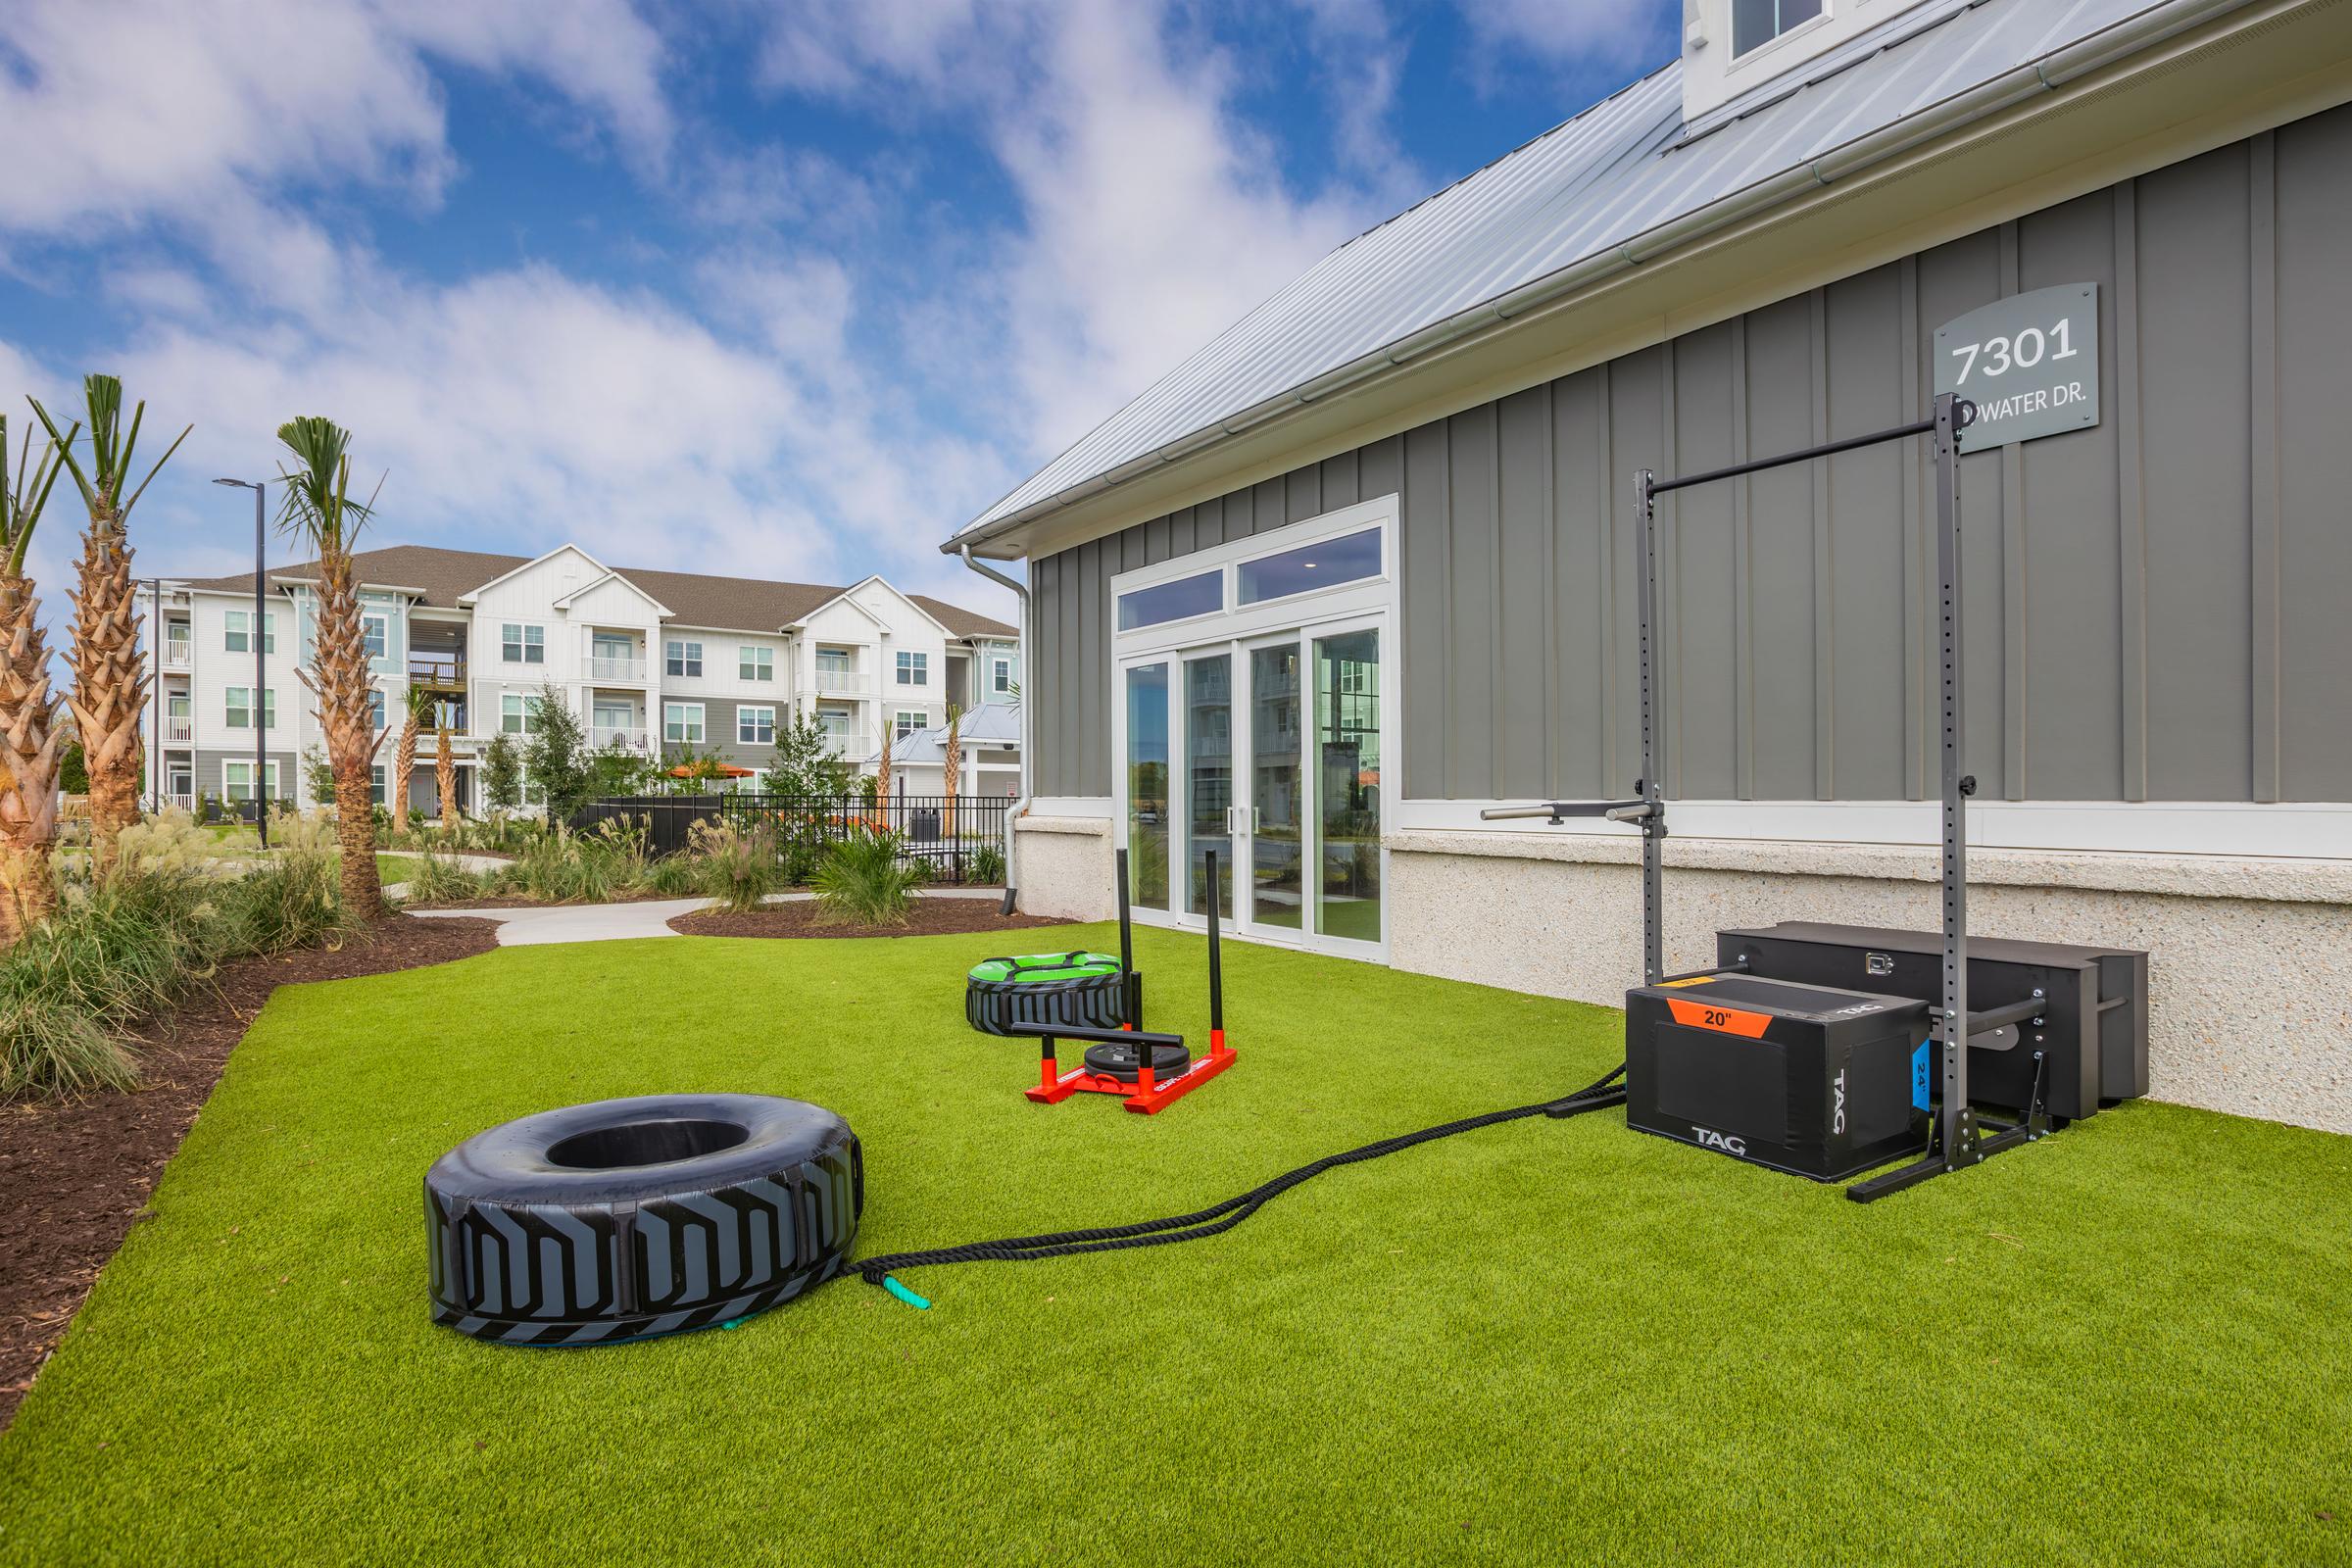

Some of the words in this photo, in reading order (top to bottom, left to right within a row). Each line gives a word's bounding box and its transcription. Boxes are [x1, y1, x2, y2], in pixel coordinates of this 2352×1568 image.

[1952, 318, 2078, 386] 7301
[2053, 381, 2086, 408] DR.
[1704, 1009, 1732, 1027] 20"
[1917, 1061, 1927, 1092] 24"
[1833, 1068, 1845, 1135] TAG
[1691, 1126, 1746, 1156] TAG
